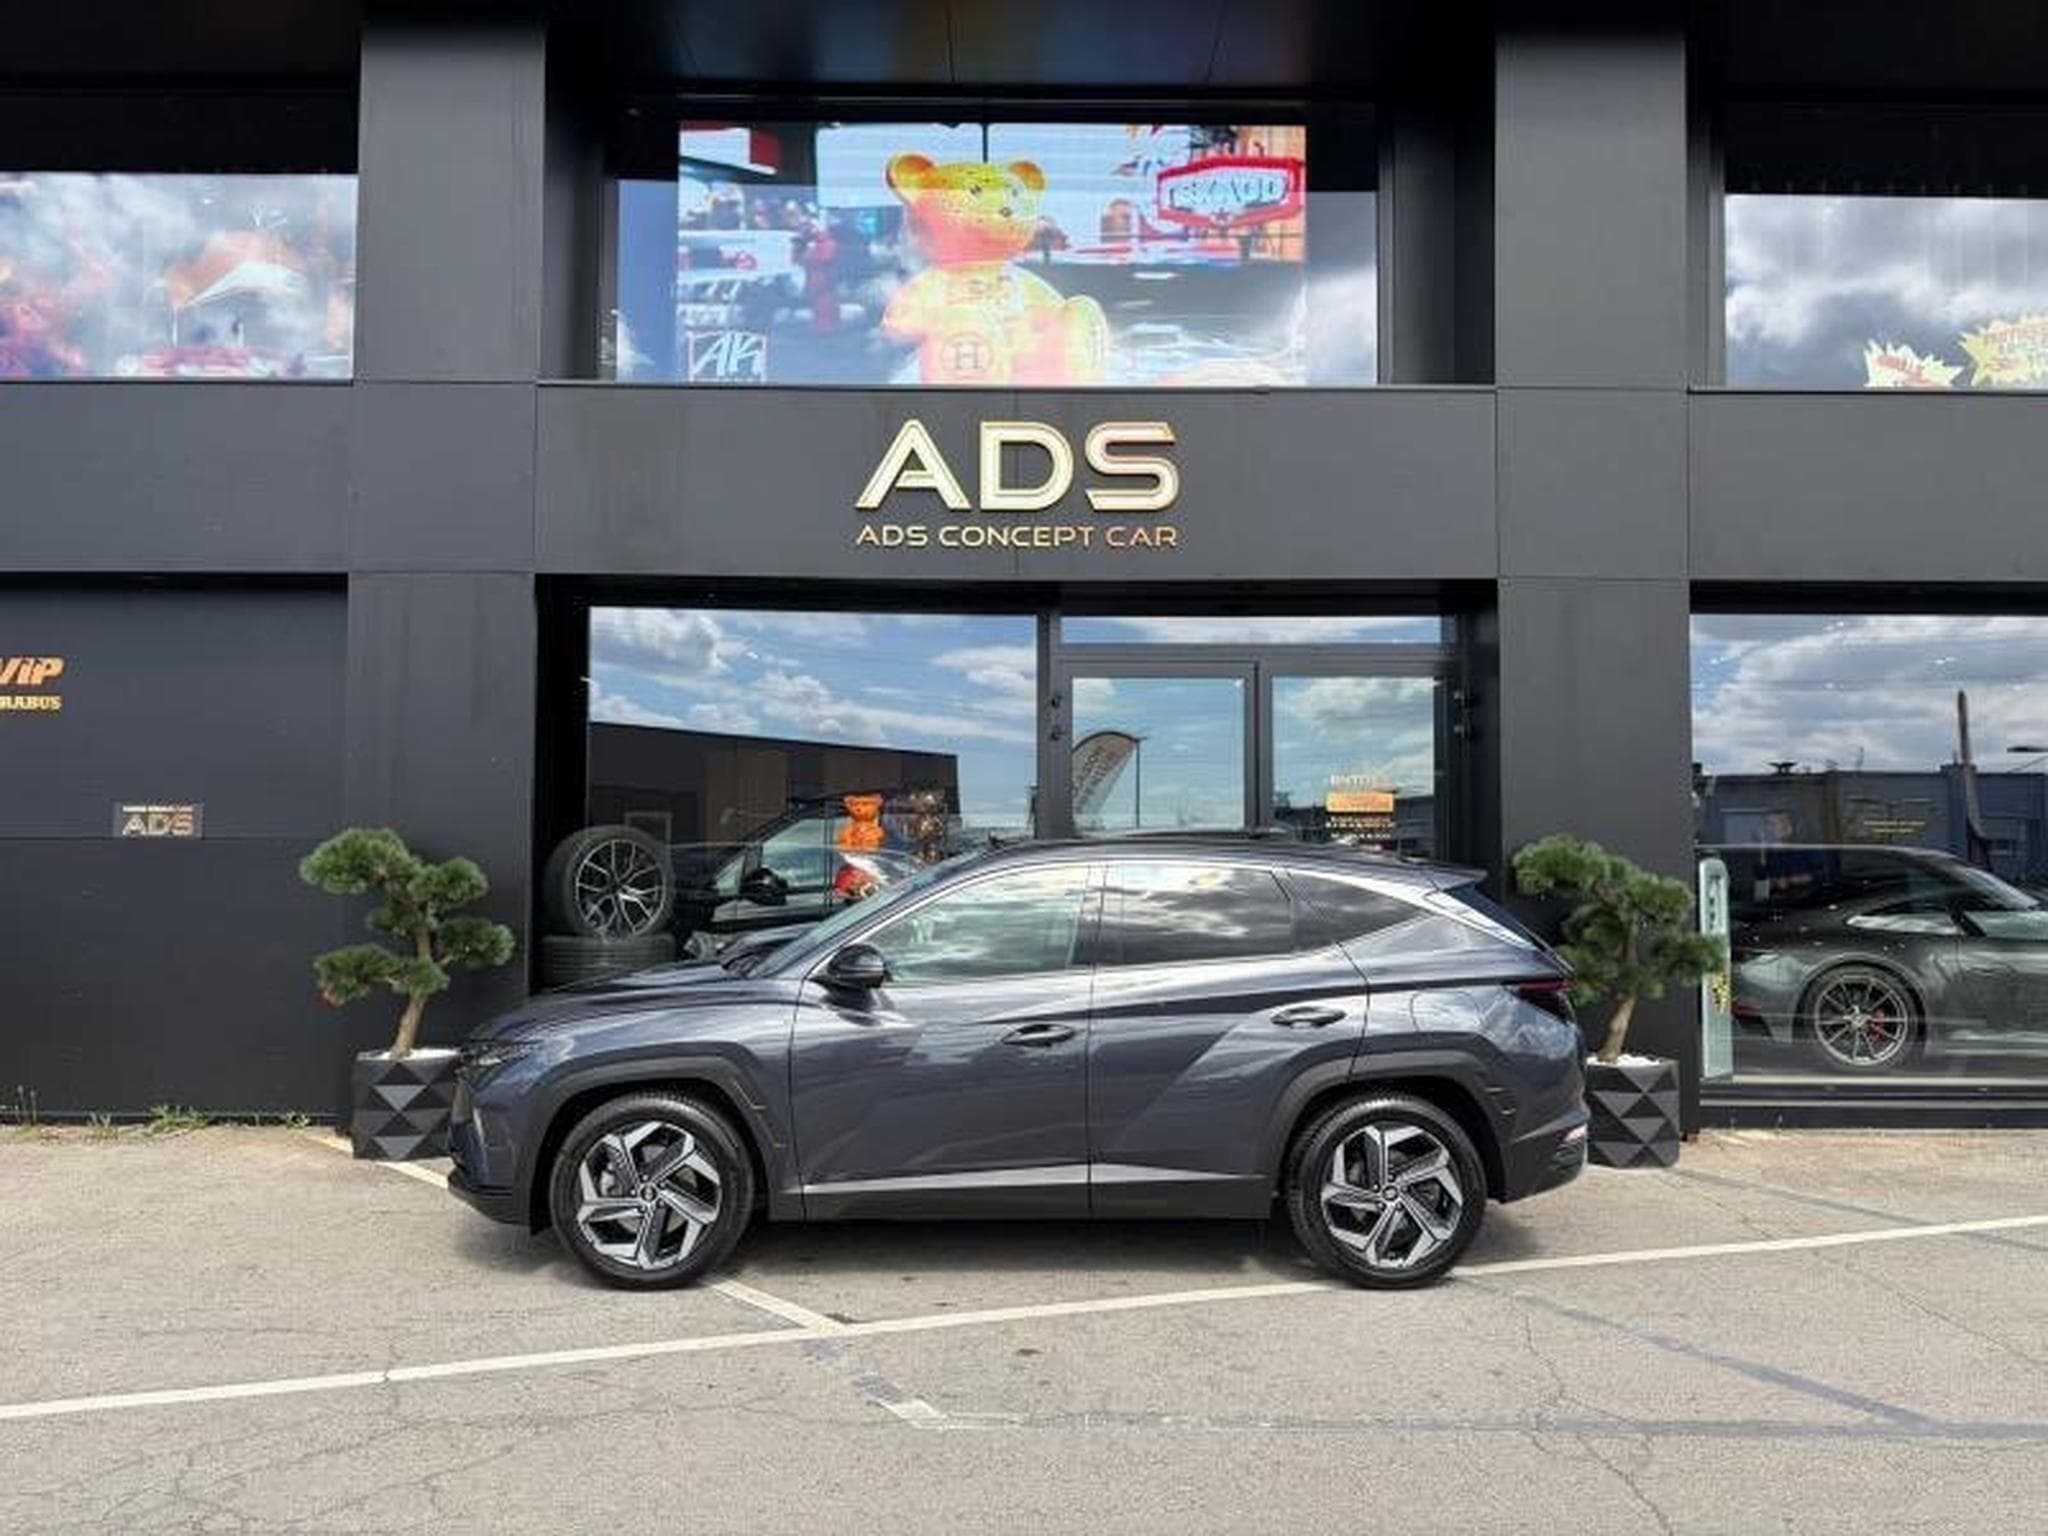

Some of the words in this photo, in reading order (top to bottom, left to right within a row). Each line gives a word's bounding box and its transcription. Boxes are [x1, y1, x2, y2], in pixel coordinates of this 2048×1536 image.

[854, 418, 1180, 512] ADS
[855, 525, 928, 547] ADS
[938, 525, 1095, 548] CONCEPT
[1104, 526, 1178, 548] CAR
[121, 813, 194, 836] ADS
